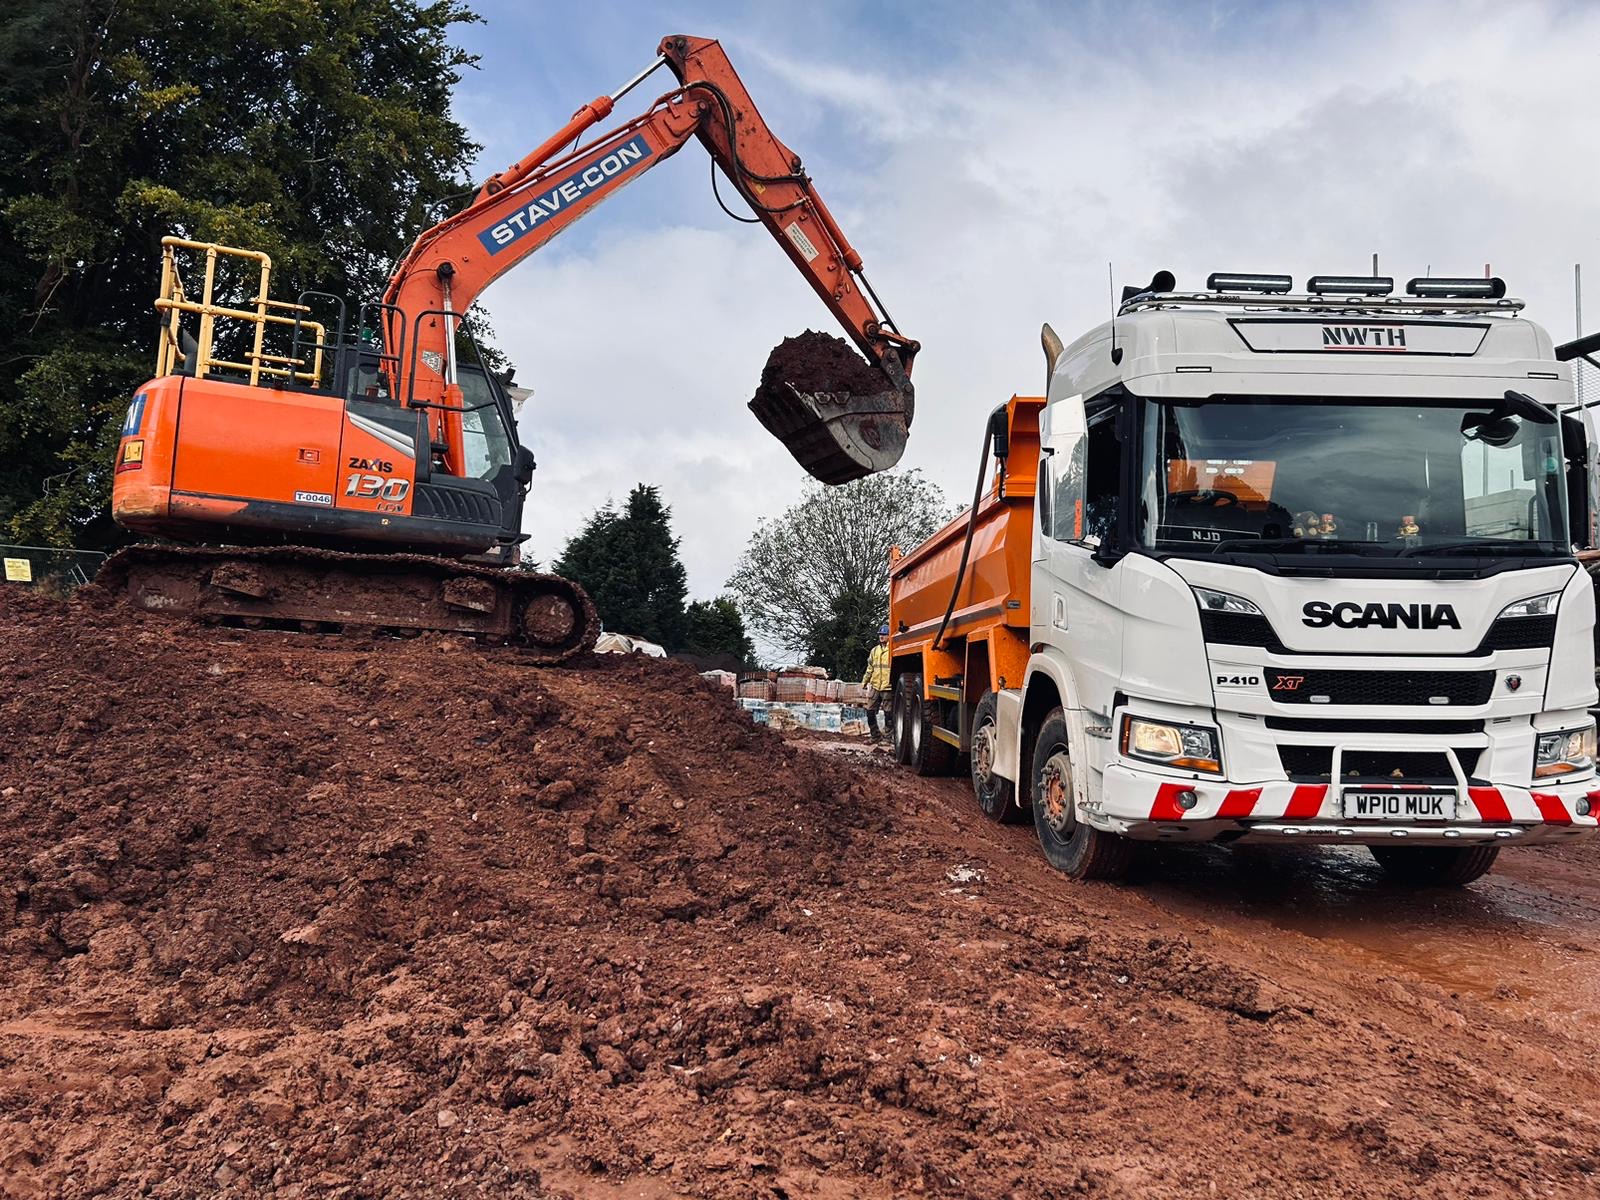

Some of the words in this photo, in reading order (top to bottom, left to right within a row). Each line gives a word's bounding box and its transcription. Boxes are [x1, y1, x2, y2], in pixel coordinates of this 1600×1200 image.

[491, 142, 642, 245] STAVE-CON
[1322, 327, 1406, 346] NWTH
[349, 457, 393, 473] ZAXIS
[345, 473, 410, 501] 130
[297, 493, 330, 503] T-0046
[1192, 530, 1221, 541] NJD
[1302, 601, 1462, 630] SCANIA
[1273, 676, 1304, 690] XT
[1357, 796, 1399, 814] WP10
[1406, 797, 1443, 815] MUK
